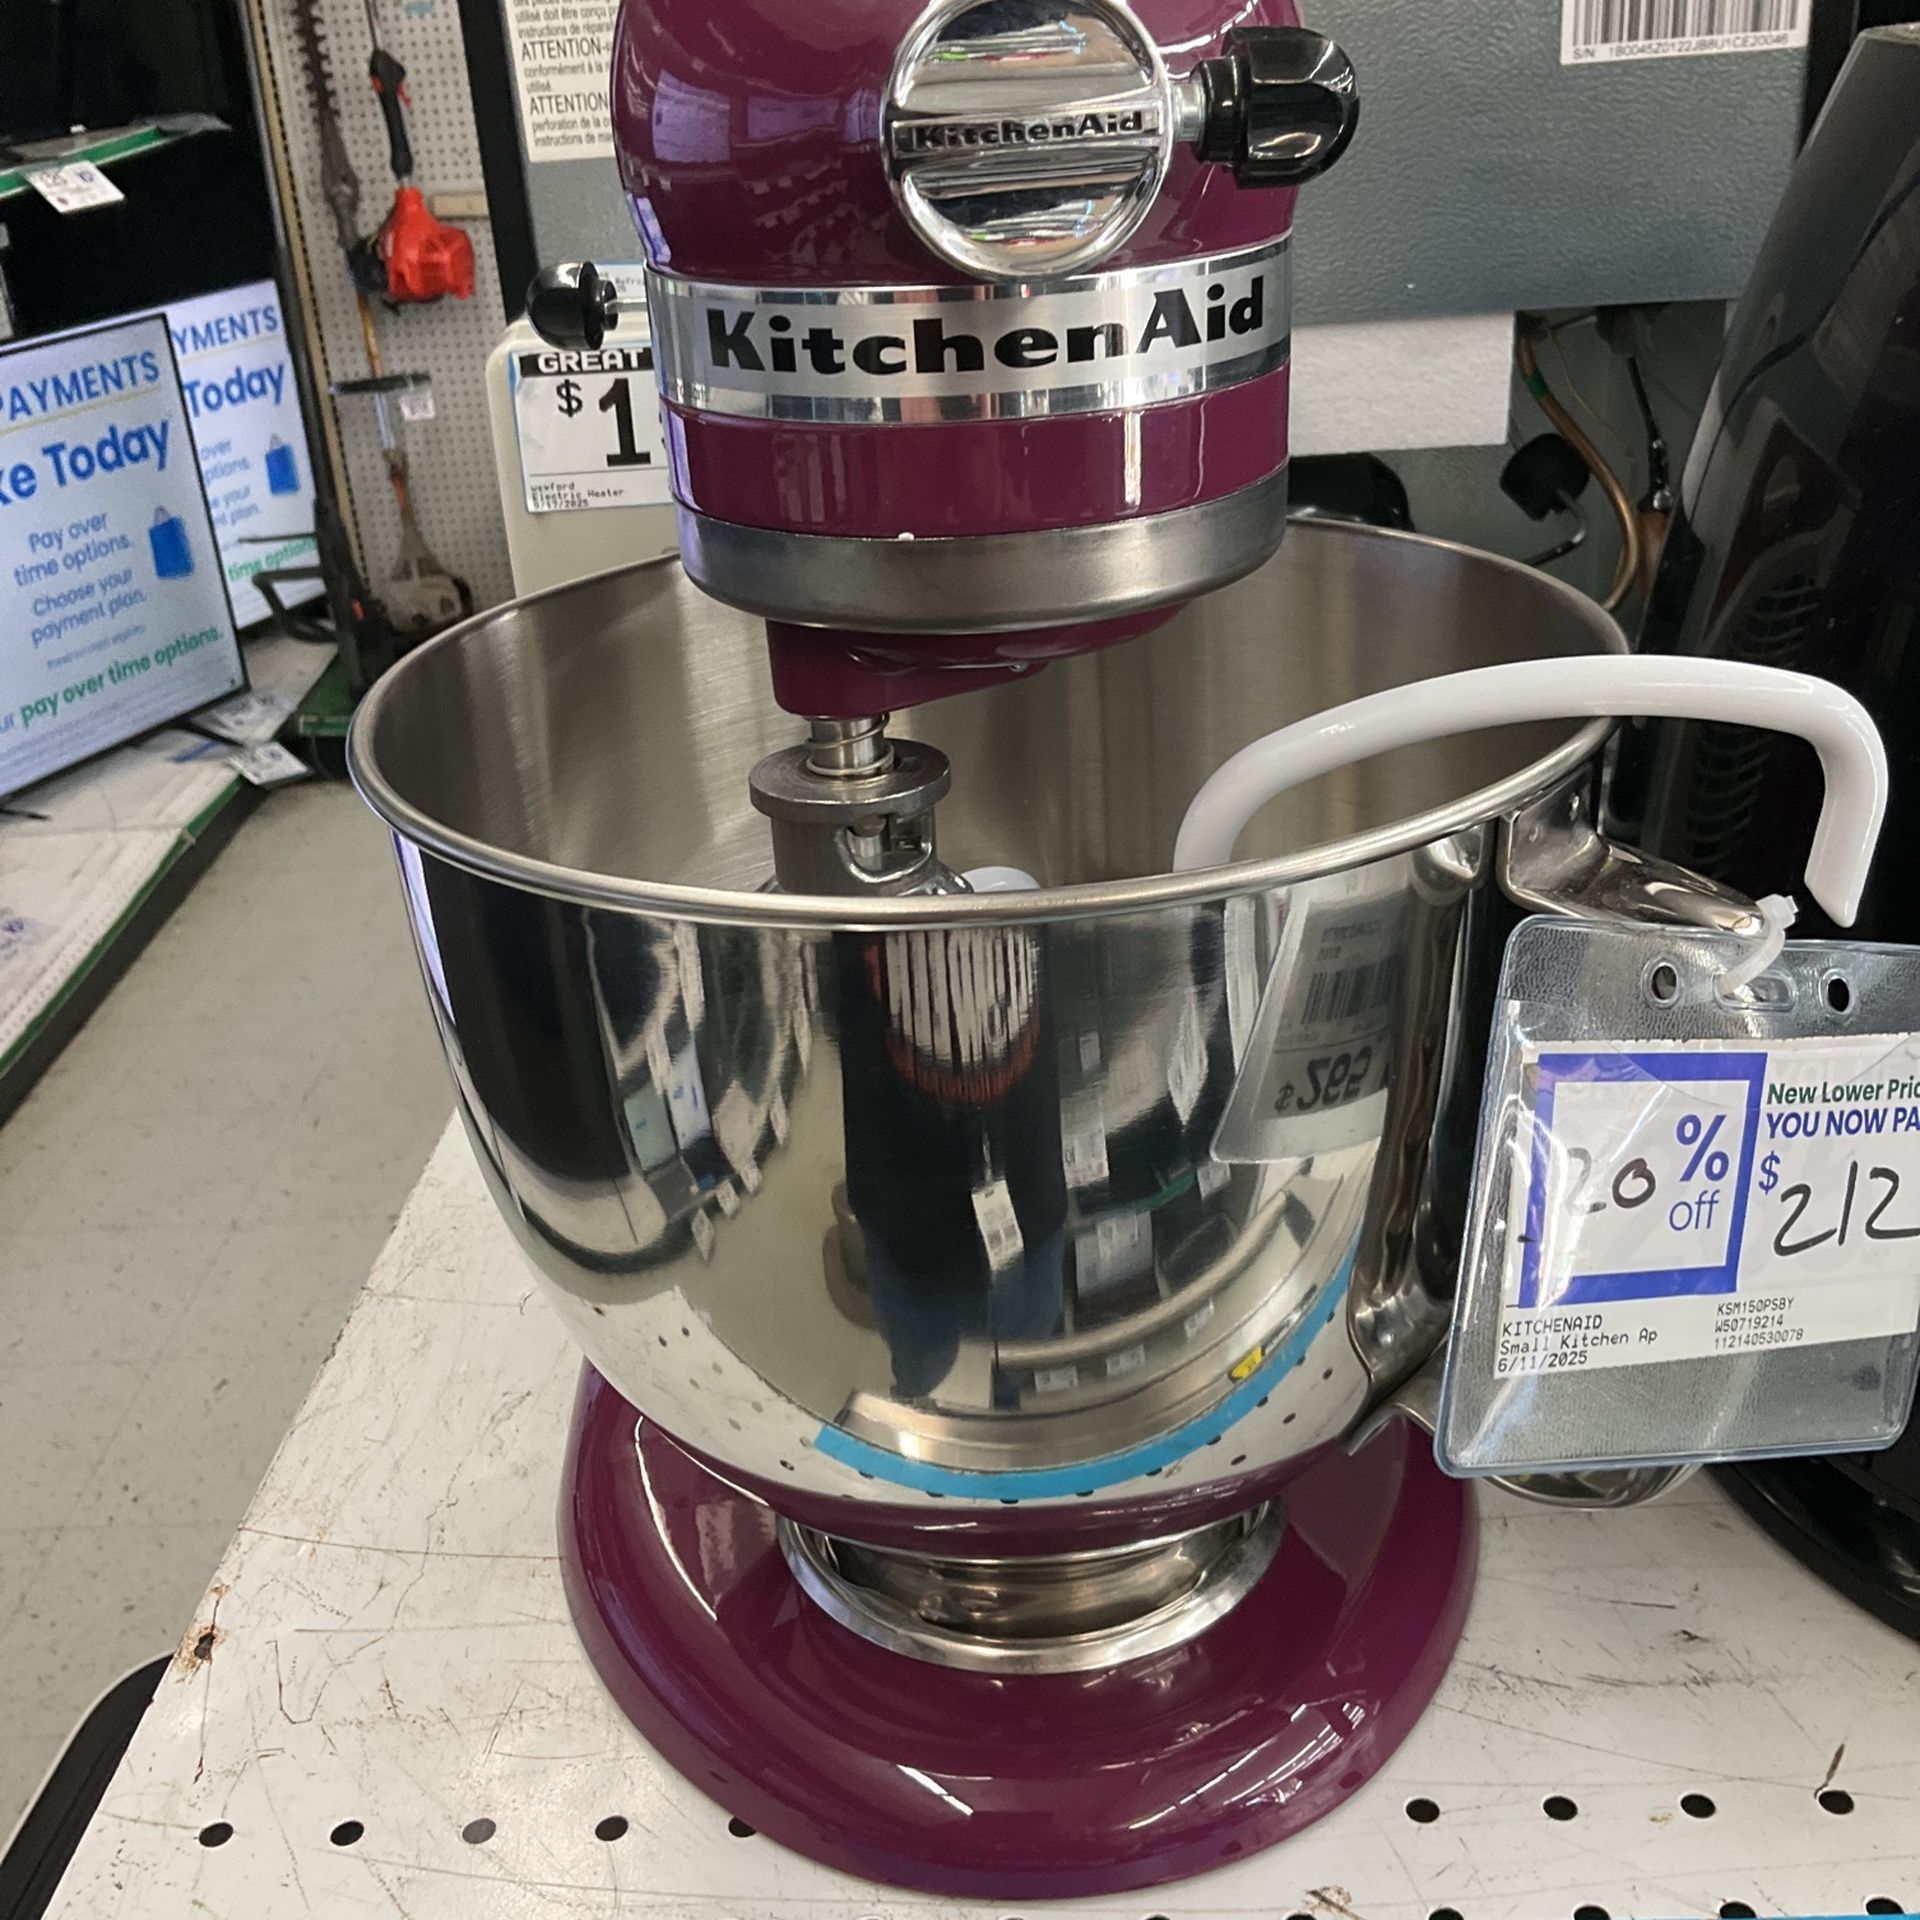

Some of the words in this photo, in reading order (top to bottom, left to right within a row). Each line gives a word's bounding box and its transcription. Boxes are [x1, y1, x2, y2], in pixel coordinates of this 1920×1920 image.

[530, 91, 609, 115] ATTENTION
[914, 111, 1143, 149] KitchenAid
[706, 275, 1265, 375] KitchenAid
[537, 347, 643, 374] GREAT
[184, 362, 284, 419] Today
[556, 379, 583, 417] $
[598, 378, 665, 467] 1
[41, 419, 168, 487] Today
[28, 530, 63, 553] Pay
[68, 512, 108, 540] over
[14, 558, 60, 587] time
[33, 584, 95, 617] Choose
[99, 568, 133, 595] your
[32, 601, 106, 648] payment
[20, 692, 59, 730] pay
[62, 673, 105, 703] over
[107, 656, 151, 685] time
[1766, 1083, 1817, 1105] New
[1821, 1081, 1884, 1103] Lower
[1766, 1110, 1820, 1139] YOU
[1825, 1107, 1888, 1137] NOW
[1565, 1147, 1656, 1216] 20
[1676, 1114, 1729, 1182] %
[1669, 1189, 1720, 1231] off
[1758, 1150, 1781, 1195] $
[1773, 1160, 1920, 1257] 212
[1500, 1336, 1550, 1356] Small
[1560, 1330, 1630, 1350] Kitchen
[1638, 1327, 1658, 1344] Ap
[1502, 1314, 1603, 1337] KITCHENAID
[1714, 1314, 1784, 1333] W50719214
[1714, 1328, 1805, 1350] 112140530078
[1497, 1350, 1588, 1372] 6/11/2025
